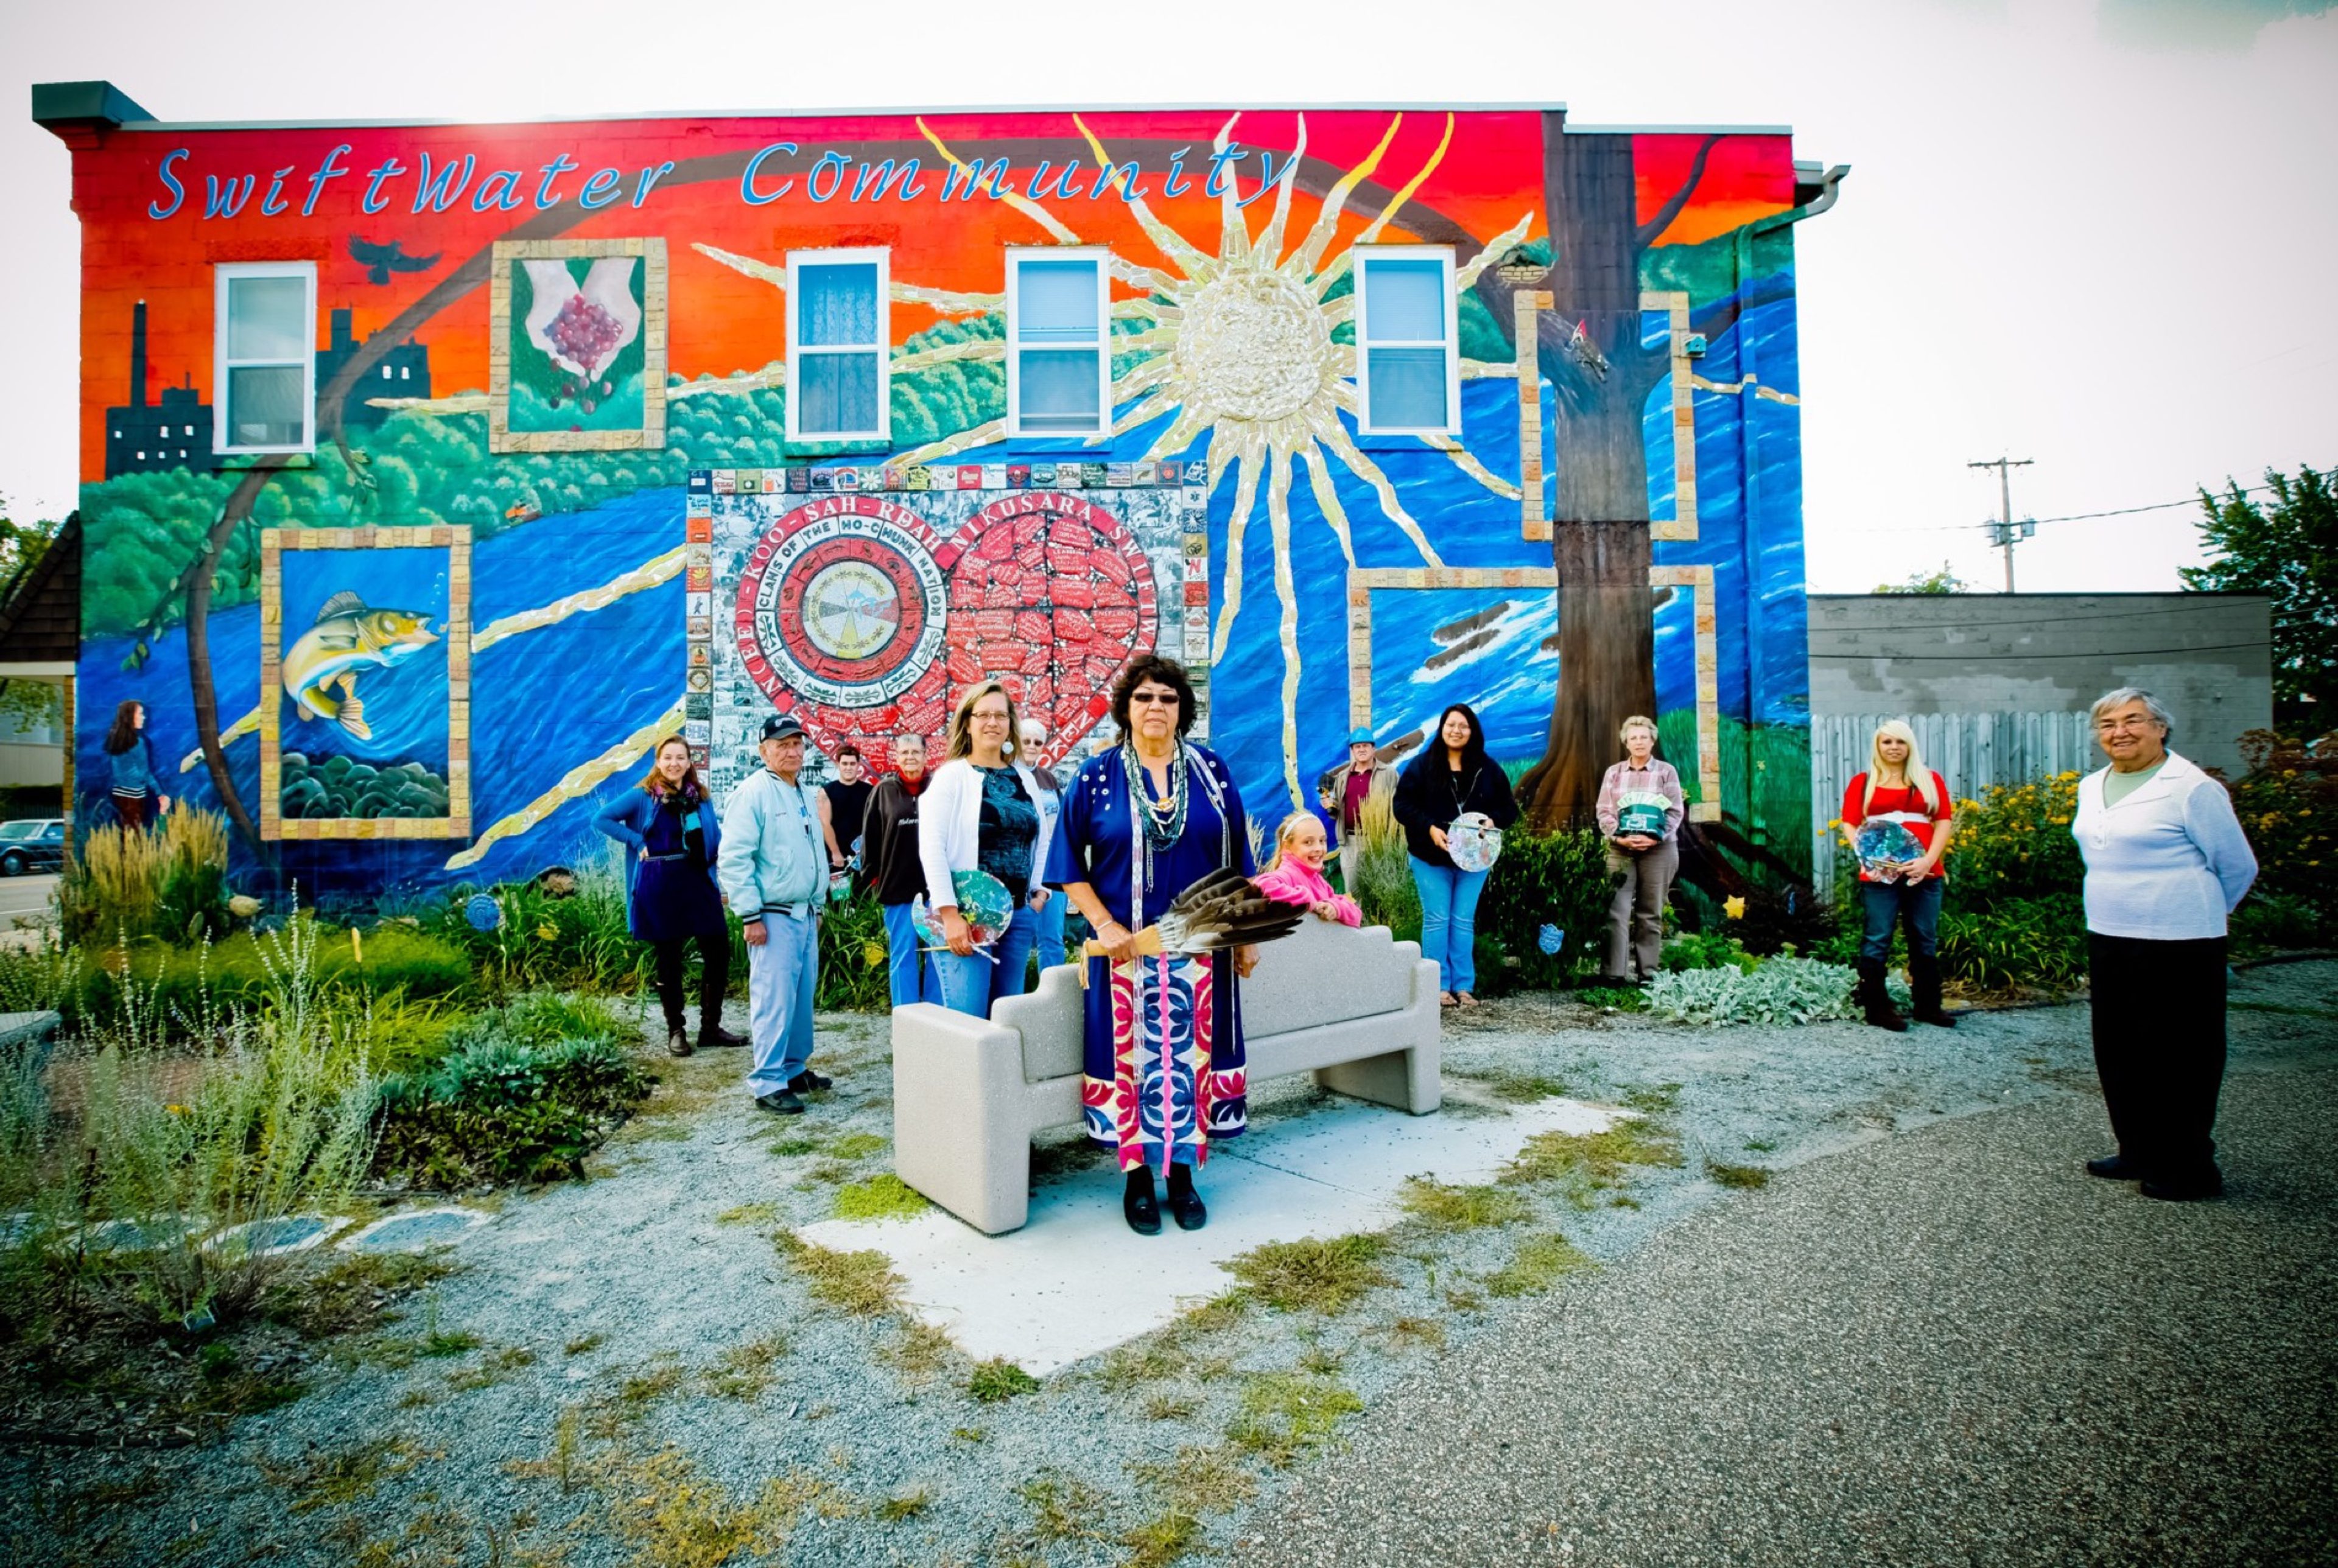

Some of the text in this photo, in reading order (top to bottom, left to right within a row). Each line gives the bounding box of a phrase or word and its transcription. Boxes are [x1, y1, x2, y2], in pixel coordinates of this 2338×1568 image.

[148, 141, 1299, 220] SwiftWater Community
[949, 495, 1090, 552] NIKUSARA
[759, 559, 783, 607] CLANS
[781, 541, 797, 558] OF
[803, 522, 831, 540] THE
[918, 558, 941, 617] NATION
